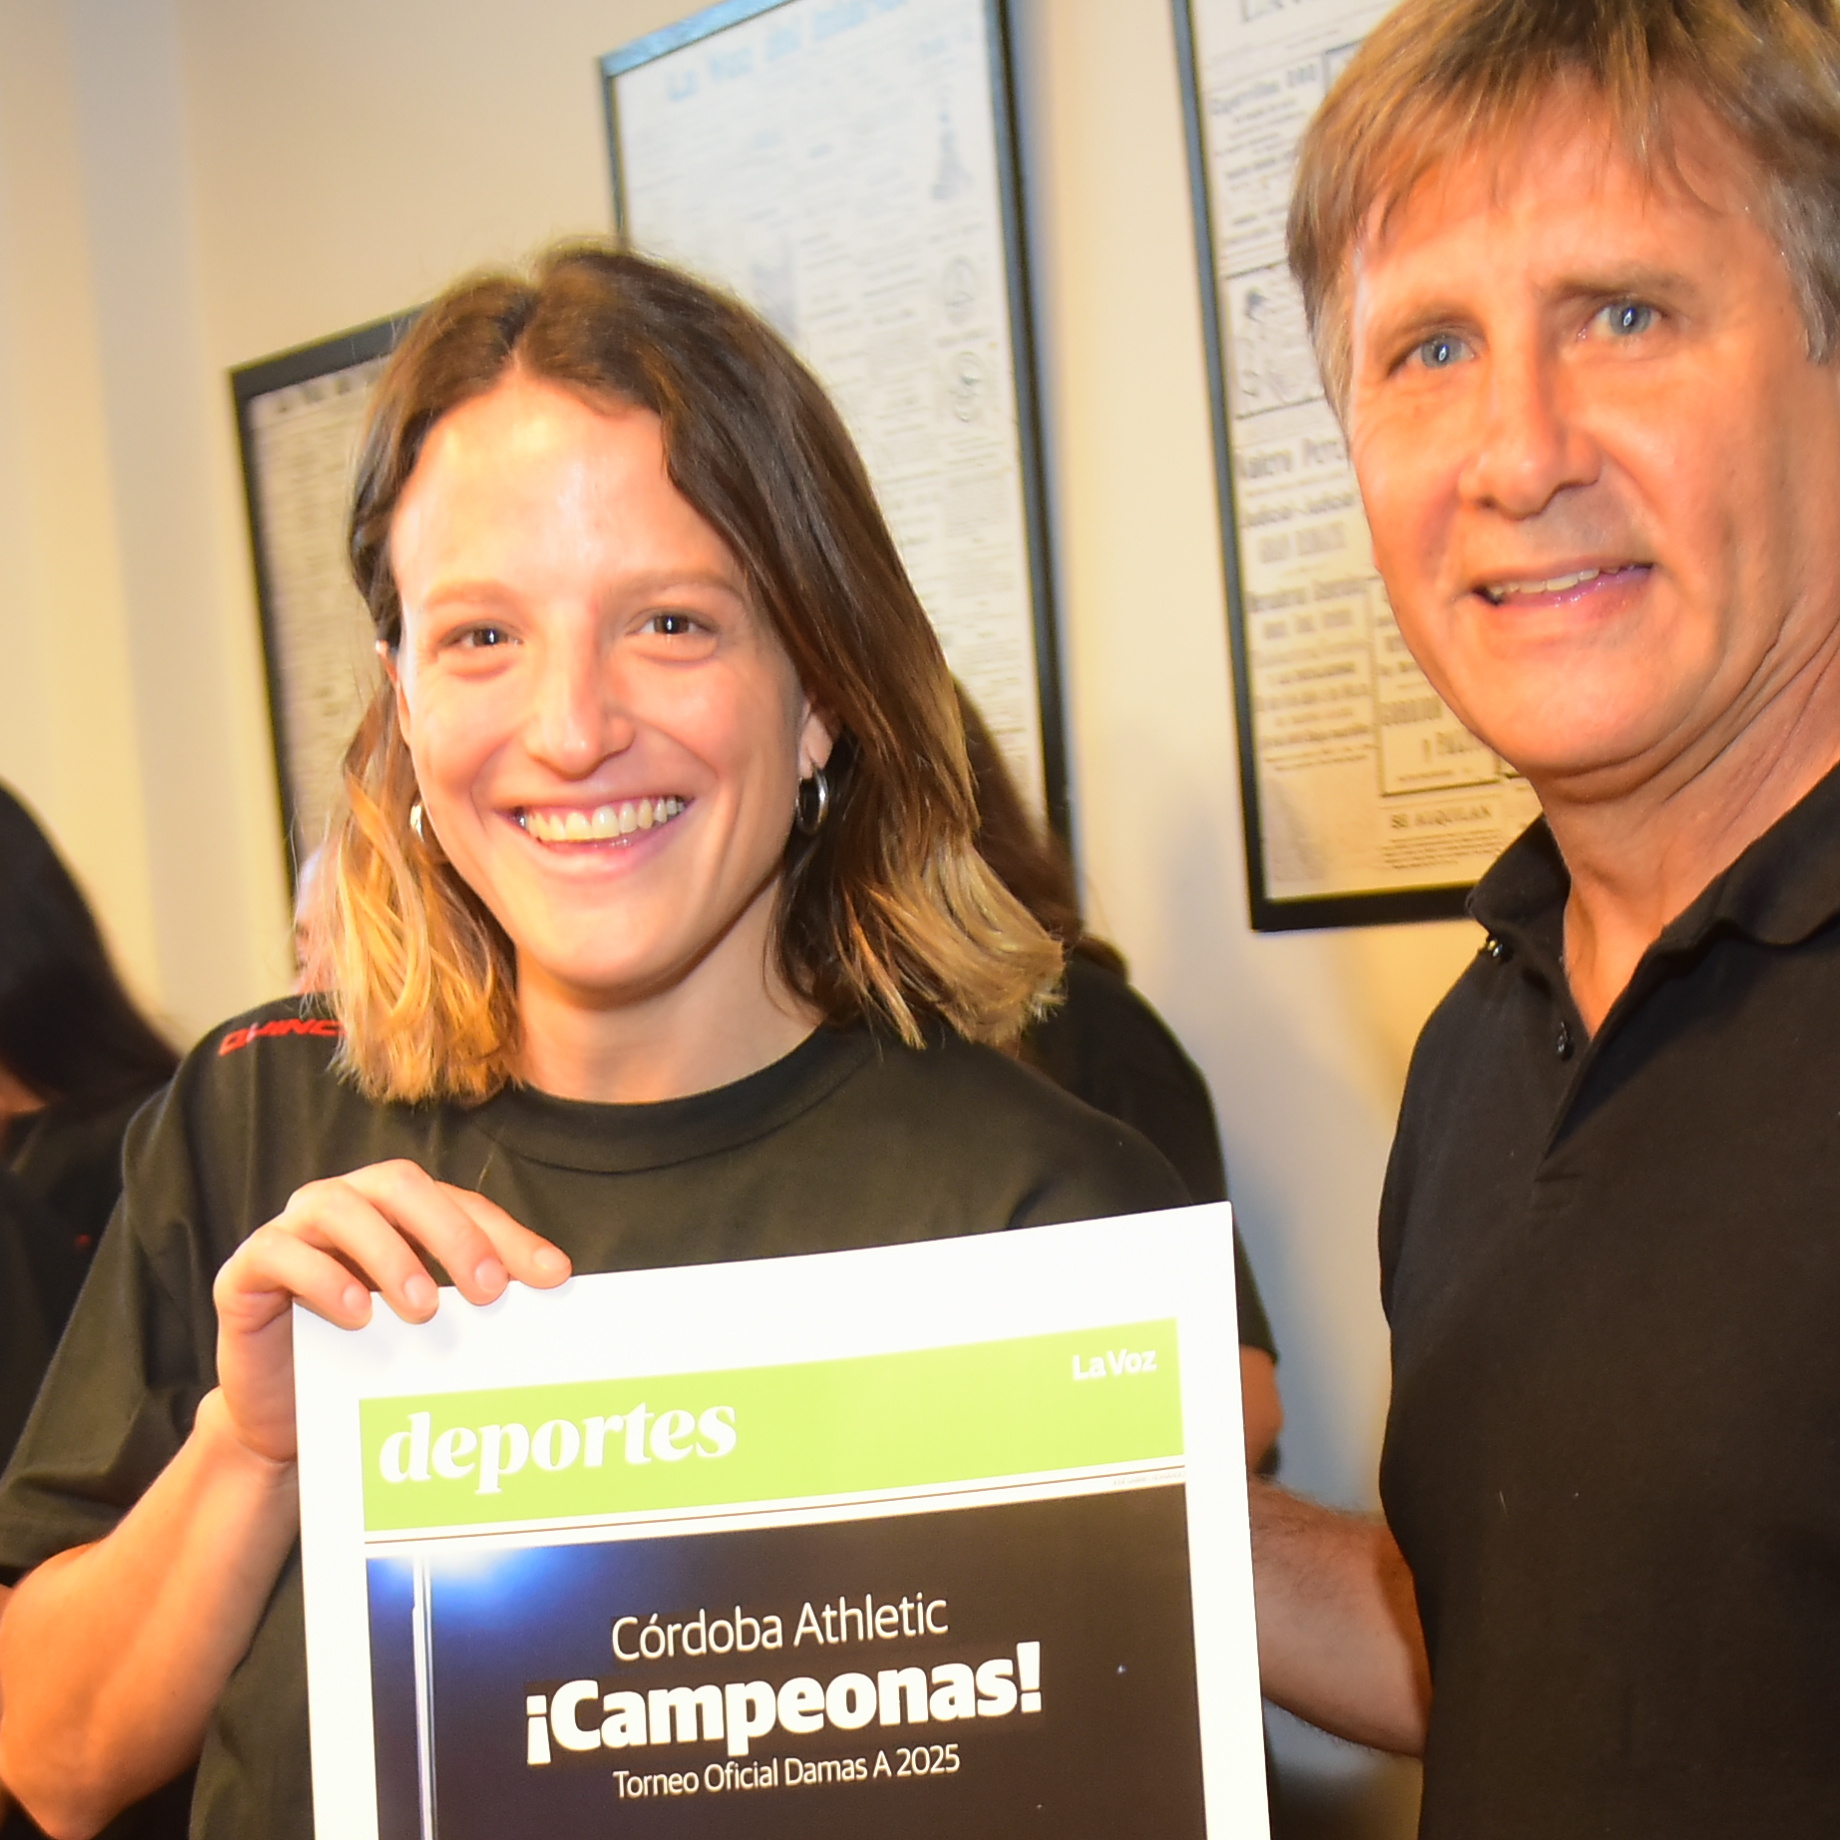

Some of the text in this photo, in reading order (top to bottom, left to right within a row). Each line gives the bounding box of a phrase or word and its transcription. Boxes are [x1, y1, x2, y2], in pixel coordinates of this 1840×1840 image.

[379, 1402, 738, 1495] deportes
[612, 1592, 949, 1661] Córdoba Athletic
[526, 1641, 1042, 1766] ¡Campeonas!
[612, 1743, 961, 1799] Torneo Oficial Damas A 2025
